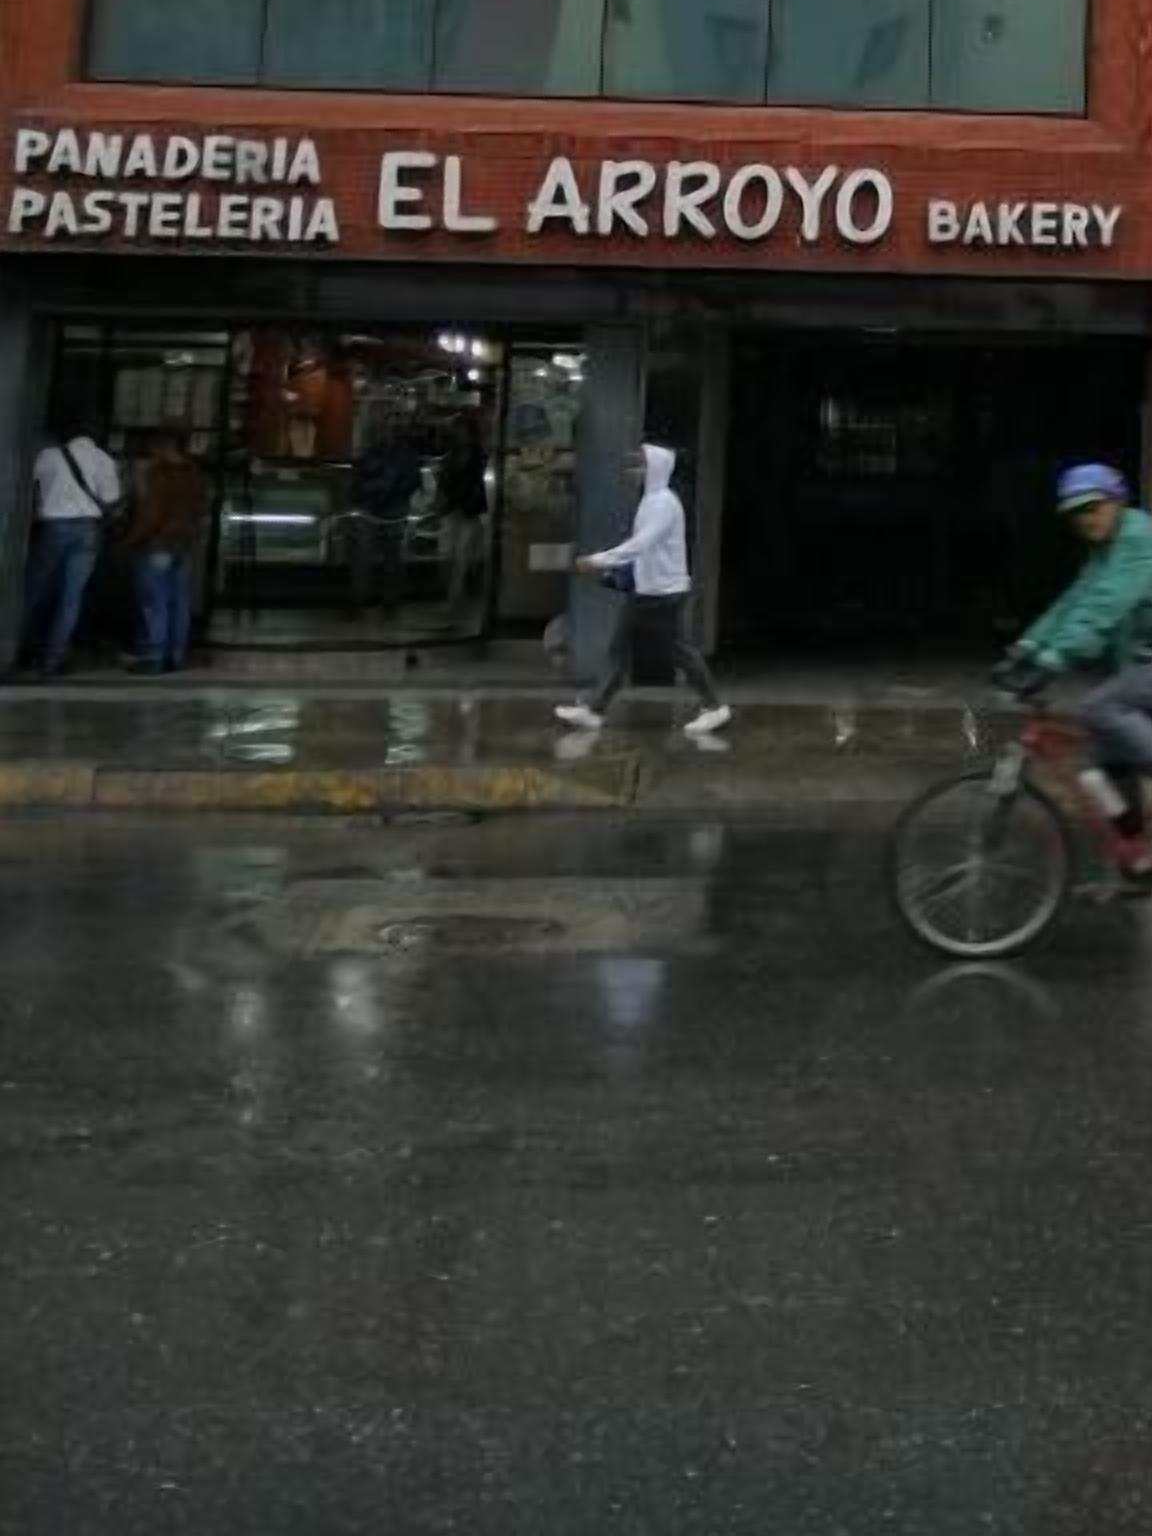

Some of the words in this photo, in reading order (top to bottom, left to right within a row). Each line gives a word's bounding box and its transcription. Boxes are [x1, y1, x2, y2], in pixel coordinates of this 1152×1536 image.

[15, 128, 321, 184] PANADERIA
[9, 189, 339, 242] PASTELERIA
[378, 151, 497, 232] EL
[526, 156, 894, 242] ARROYO
[927, 199, 1122, 245] BAKERY
